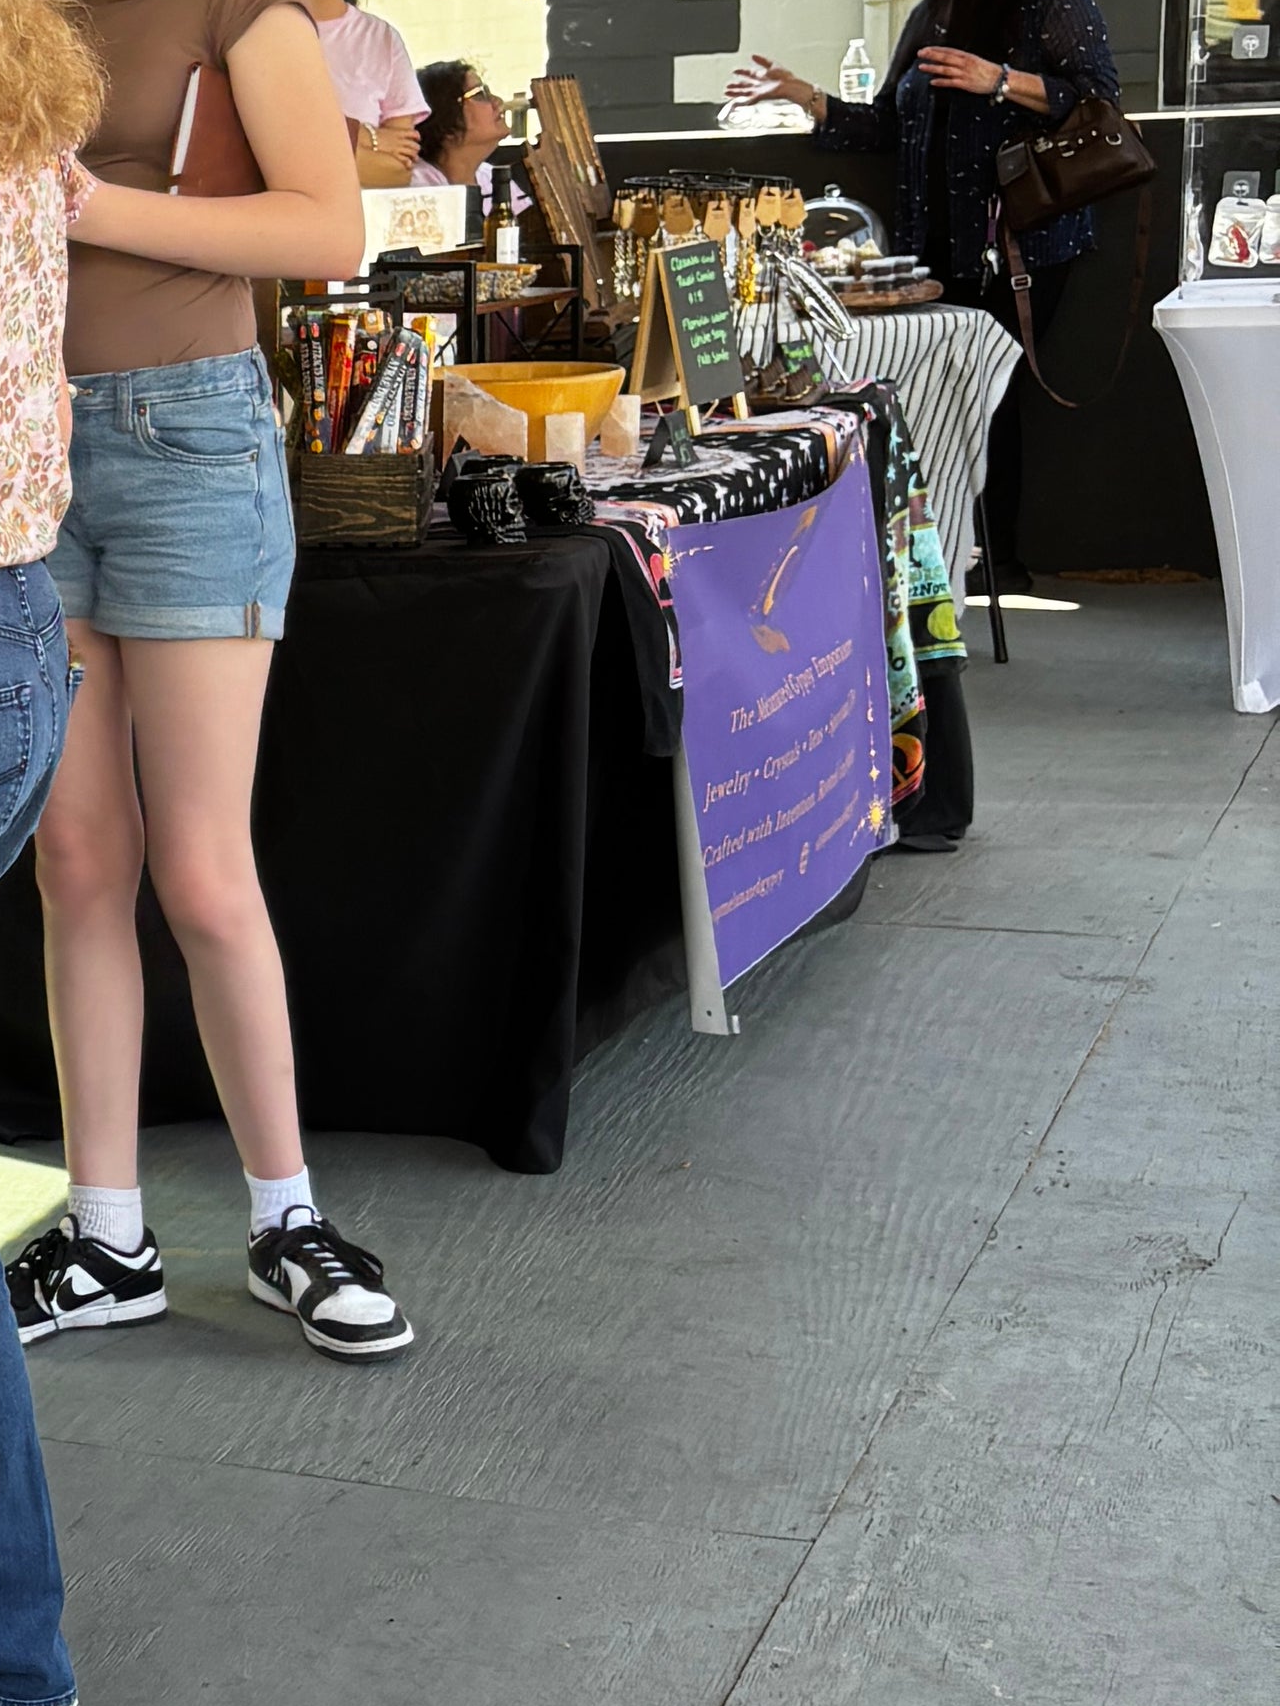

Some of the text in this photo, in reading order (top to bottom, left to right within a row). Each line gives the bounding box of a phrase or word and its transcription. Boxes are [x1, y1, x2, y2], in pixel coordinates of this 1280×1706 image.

[701, 250, 716, 263] and
[730, 707, 755, 734] The
[703, 769, 752, 813] Jewelry
[746, 813, 774, 846] with
